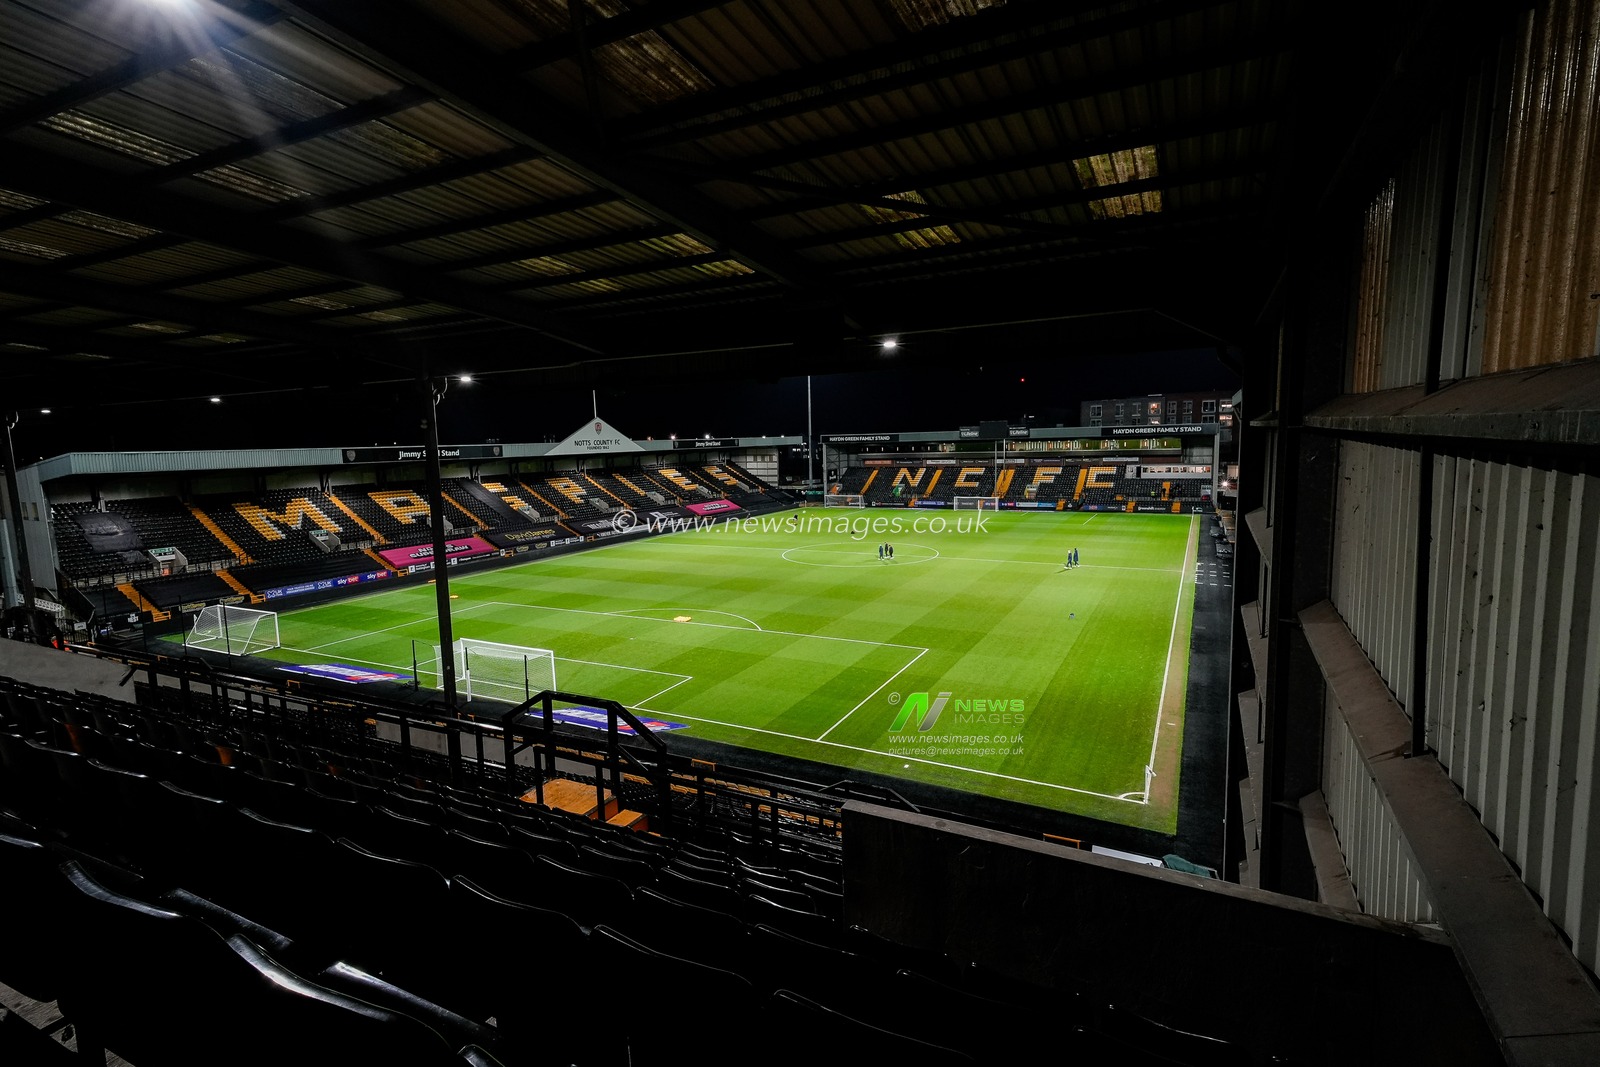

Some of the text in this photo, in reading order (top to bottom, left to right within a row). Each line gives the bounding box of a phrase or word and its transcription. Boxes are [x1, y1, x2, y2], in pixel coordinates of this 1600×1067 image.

[398, 450, 421, 460] Jimmy
[441, 449, 460, 457] Stand
[418, 543, 454, 553] NOS
[337, 575, 359, 586] sky bet
[367, 570, 387, 581] sky bet
